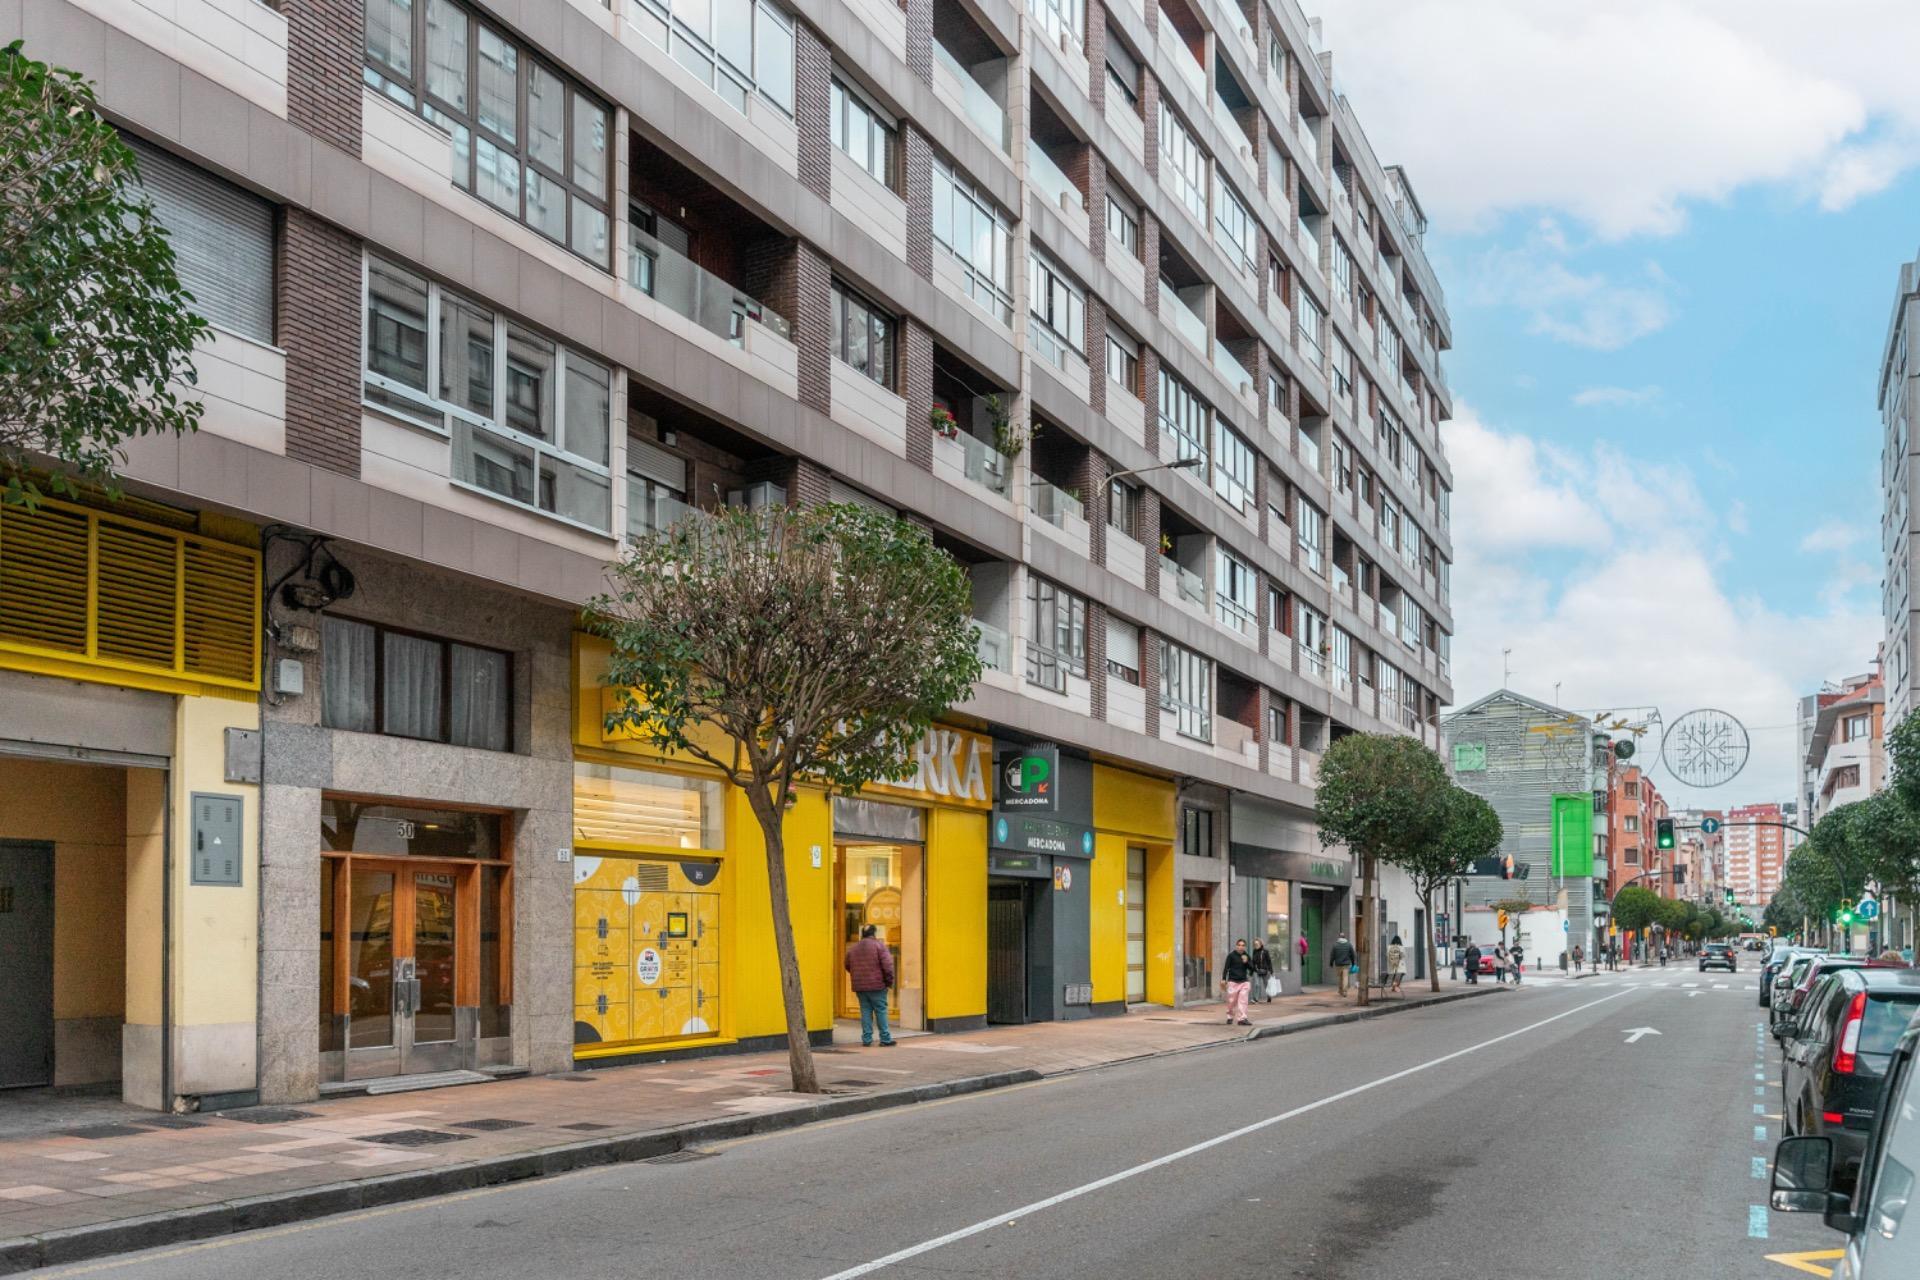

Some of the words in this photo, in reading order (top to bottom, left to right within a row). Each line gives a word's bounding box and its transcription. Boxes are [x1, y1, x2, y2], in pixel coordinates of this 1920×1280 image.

[1021, 756, 1049, 793] P
[1005, 797, 1049, 805] MERCADONA
[398, 822, 413, 838] 50
[1027, 836, 1066, 852] MERCADONA
